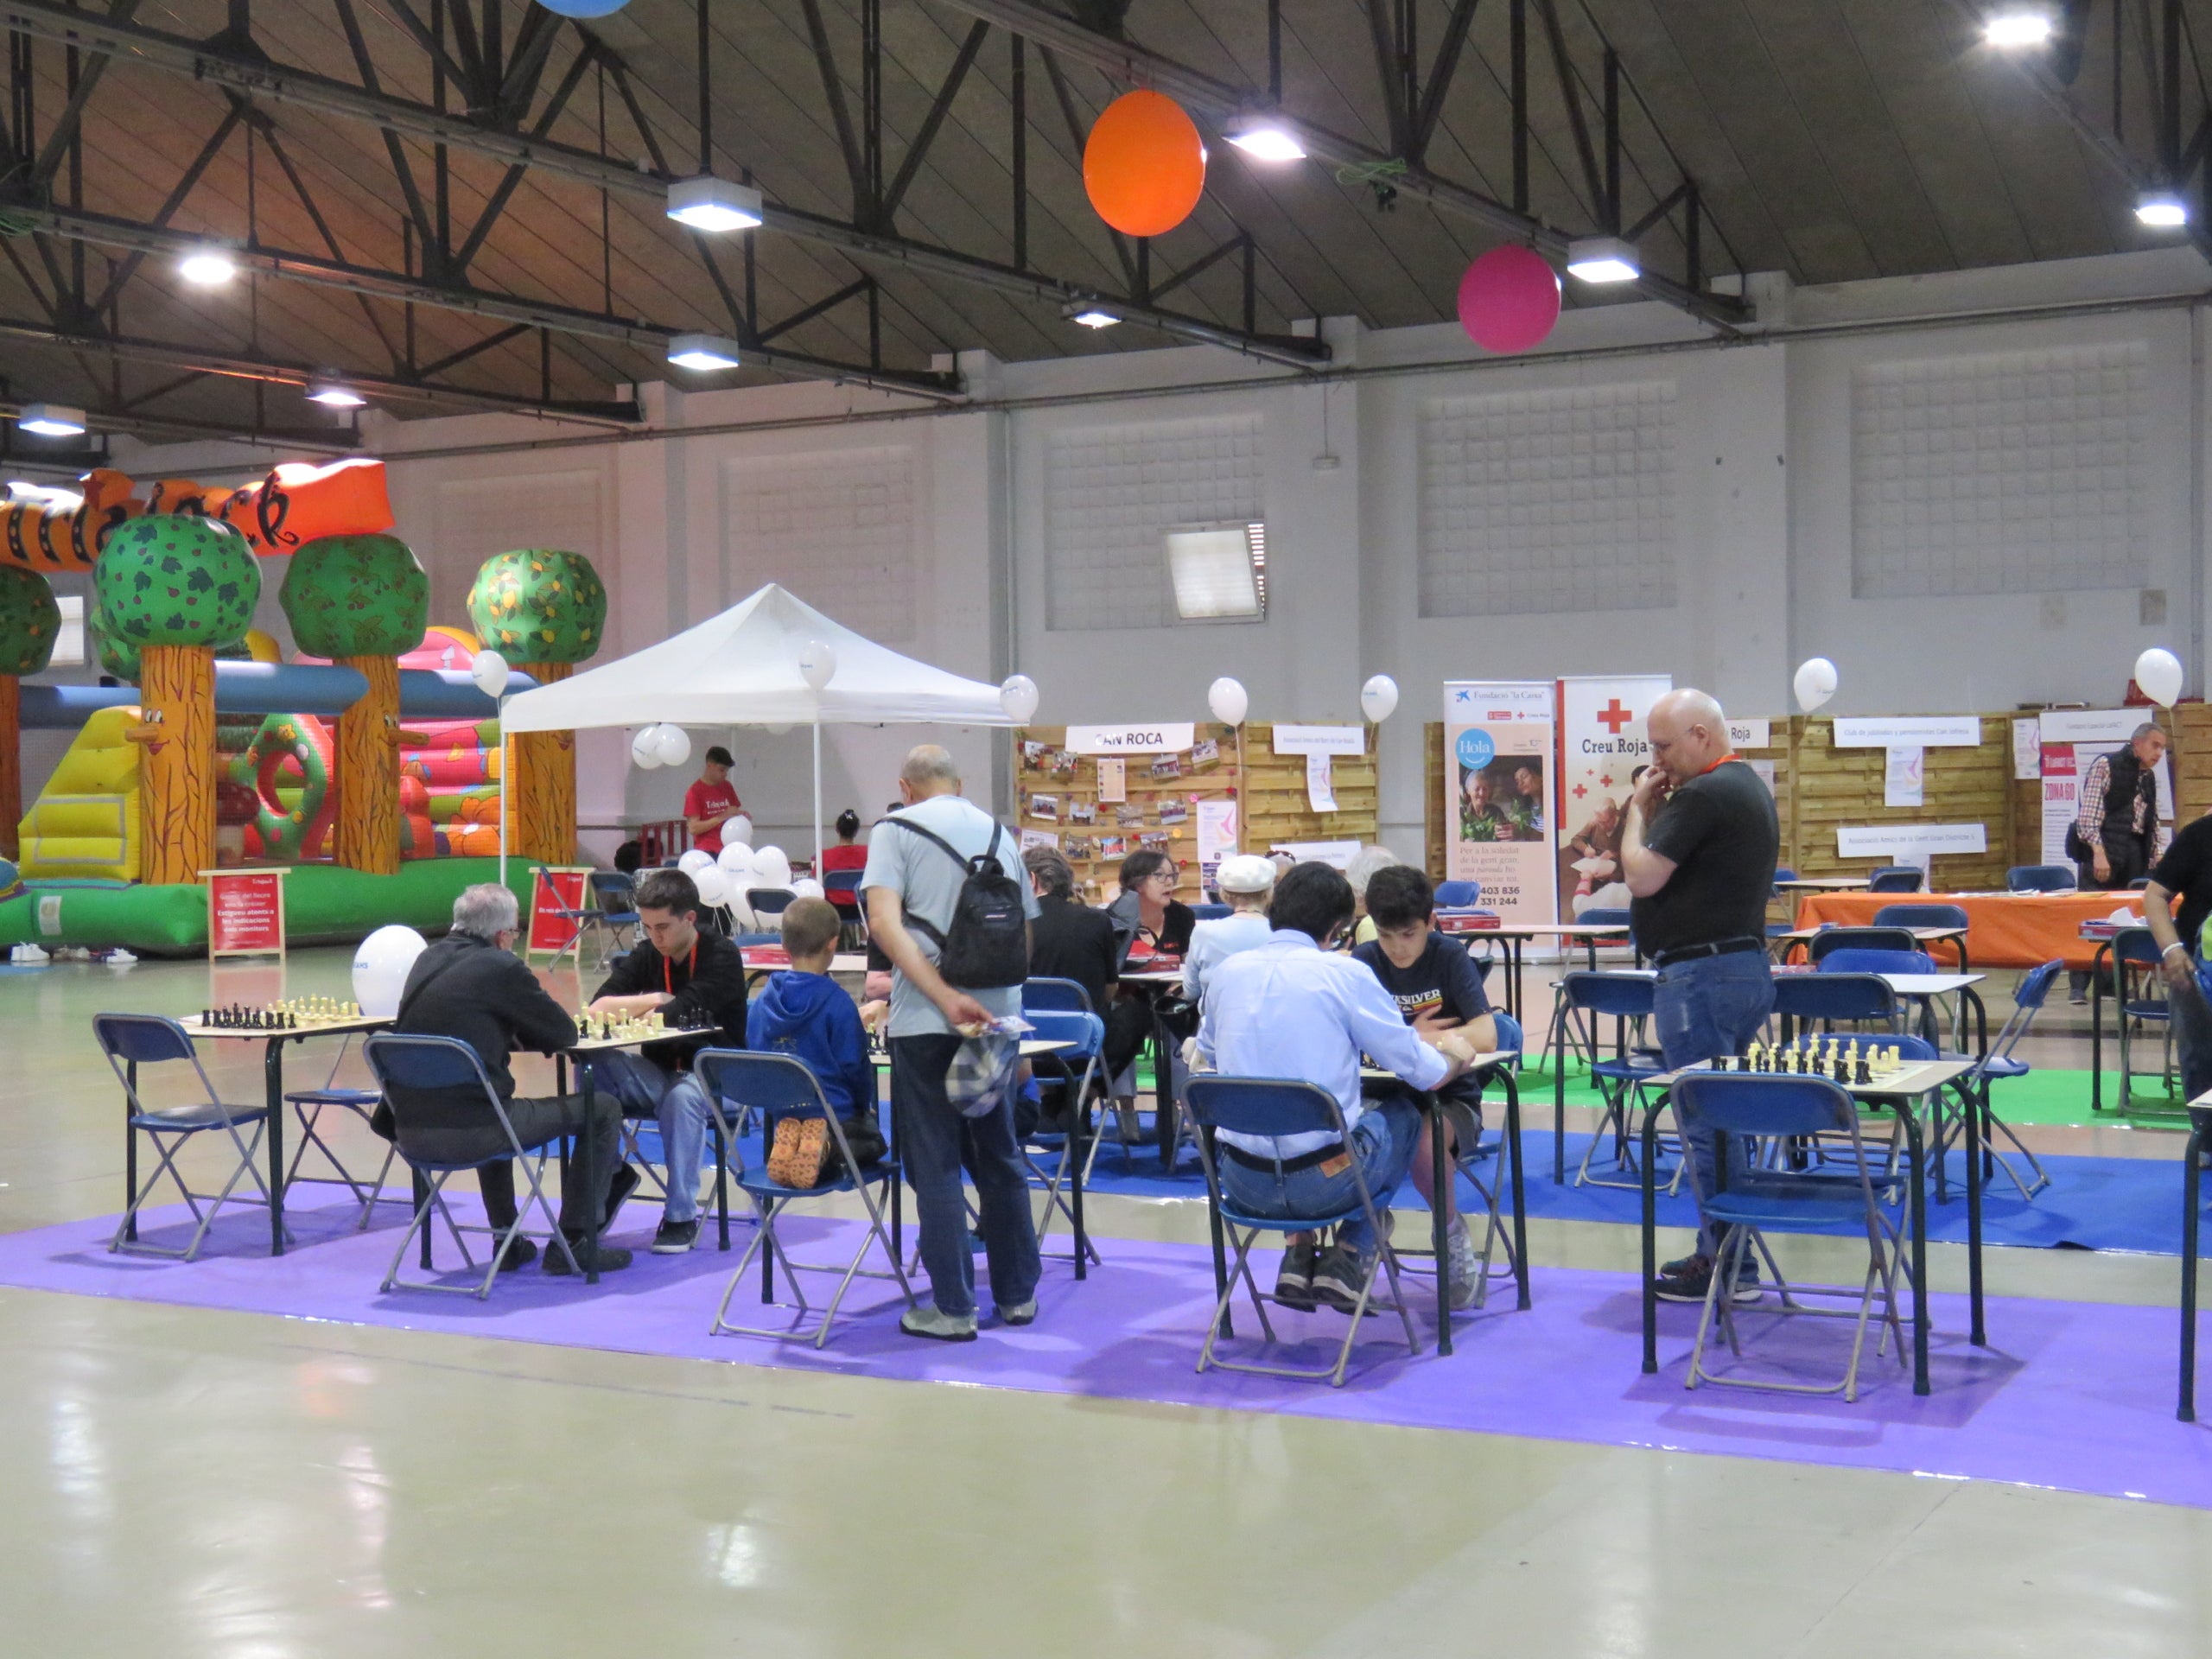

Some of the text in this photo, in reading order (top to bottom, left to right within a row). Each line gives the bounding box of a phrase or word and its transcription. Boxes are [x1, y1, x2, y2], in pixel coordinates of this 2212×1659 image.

[1126, 733, 1164, 745] ROCA
[1731, 727, 1751, 742] Roja
[1459, 741, 1490, 754] Hola
[1582, 738, 1649, 757] Creu Roja
[2044, 783, 2063, 801] ZONA
[1480, 886, 1521, 895] 403 836
[1480, 898, 1497, 906] 331
